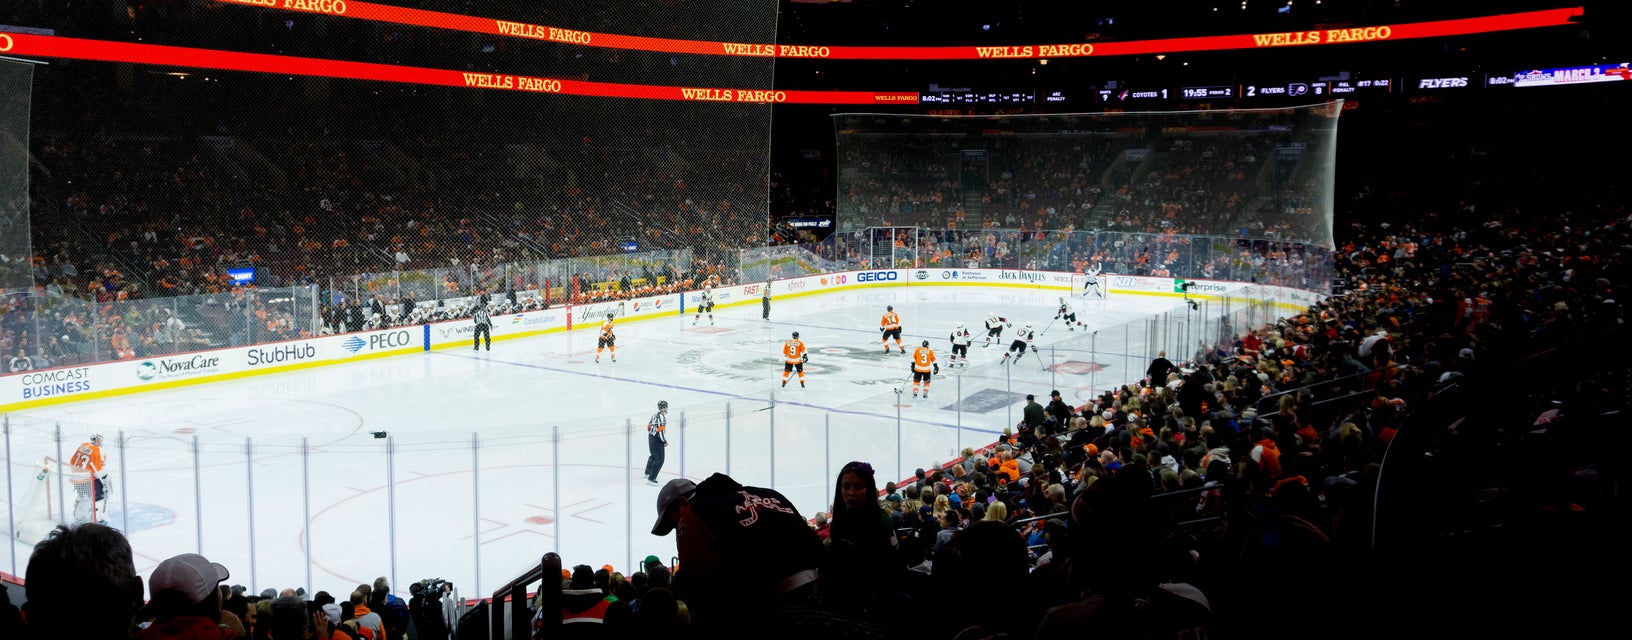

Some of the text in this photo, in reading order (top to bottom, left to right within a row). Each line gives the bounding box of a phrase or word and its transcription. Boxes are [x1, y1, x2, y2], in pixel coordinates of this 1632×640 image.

[496, 20, 591, 45] WELLS FARGO
[1253, 26, 1392, 48] WELLS FARGO
[722, 42, 830, 58] WELLS FARGO
[976, 43, 1094, 58] WELLS FARGO
[462, 72, 562, 92] WELLS FARGO
[1554, 68, 1591, 82] MARCH
[1593, 67, 1601, 80] 3
[1418, 77, 1469, 89] FLYERS
[681, 88, 786, 103] WELLS FARGO
[1103, 94, 1109, 102] 9
[1162, 88, 1168, 99] 1
[1184, 88, 1208, 98] 19:55
[1225, 88, 1232, 96] 2
[1247, 86, 1256, 96] 2
[857, 271, 898, 282] GEICO
[998, 270, 1017, 279] JACK
[787, 280, 806, 292] xfinity
[886, 316, 897, 325] 14
[369, 330, 410, 350] PECO
[247, 343, 315, 366] StubHub
[789, 345, 797, 356] 9
[159, 355, 219, 374] NovaCare
[920, 353, 928, 364] 3
[22, 368, 89, 386] COMCAST
[23, 380, 90, 399] BUSINESS
